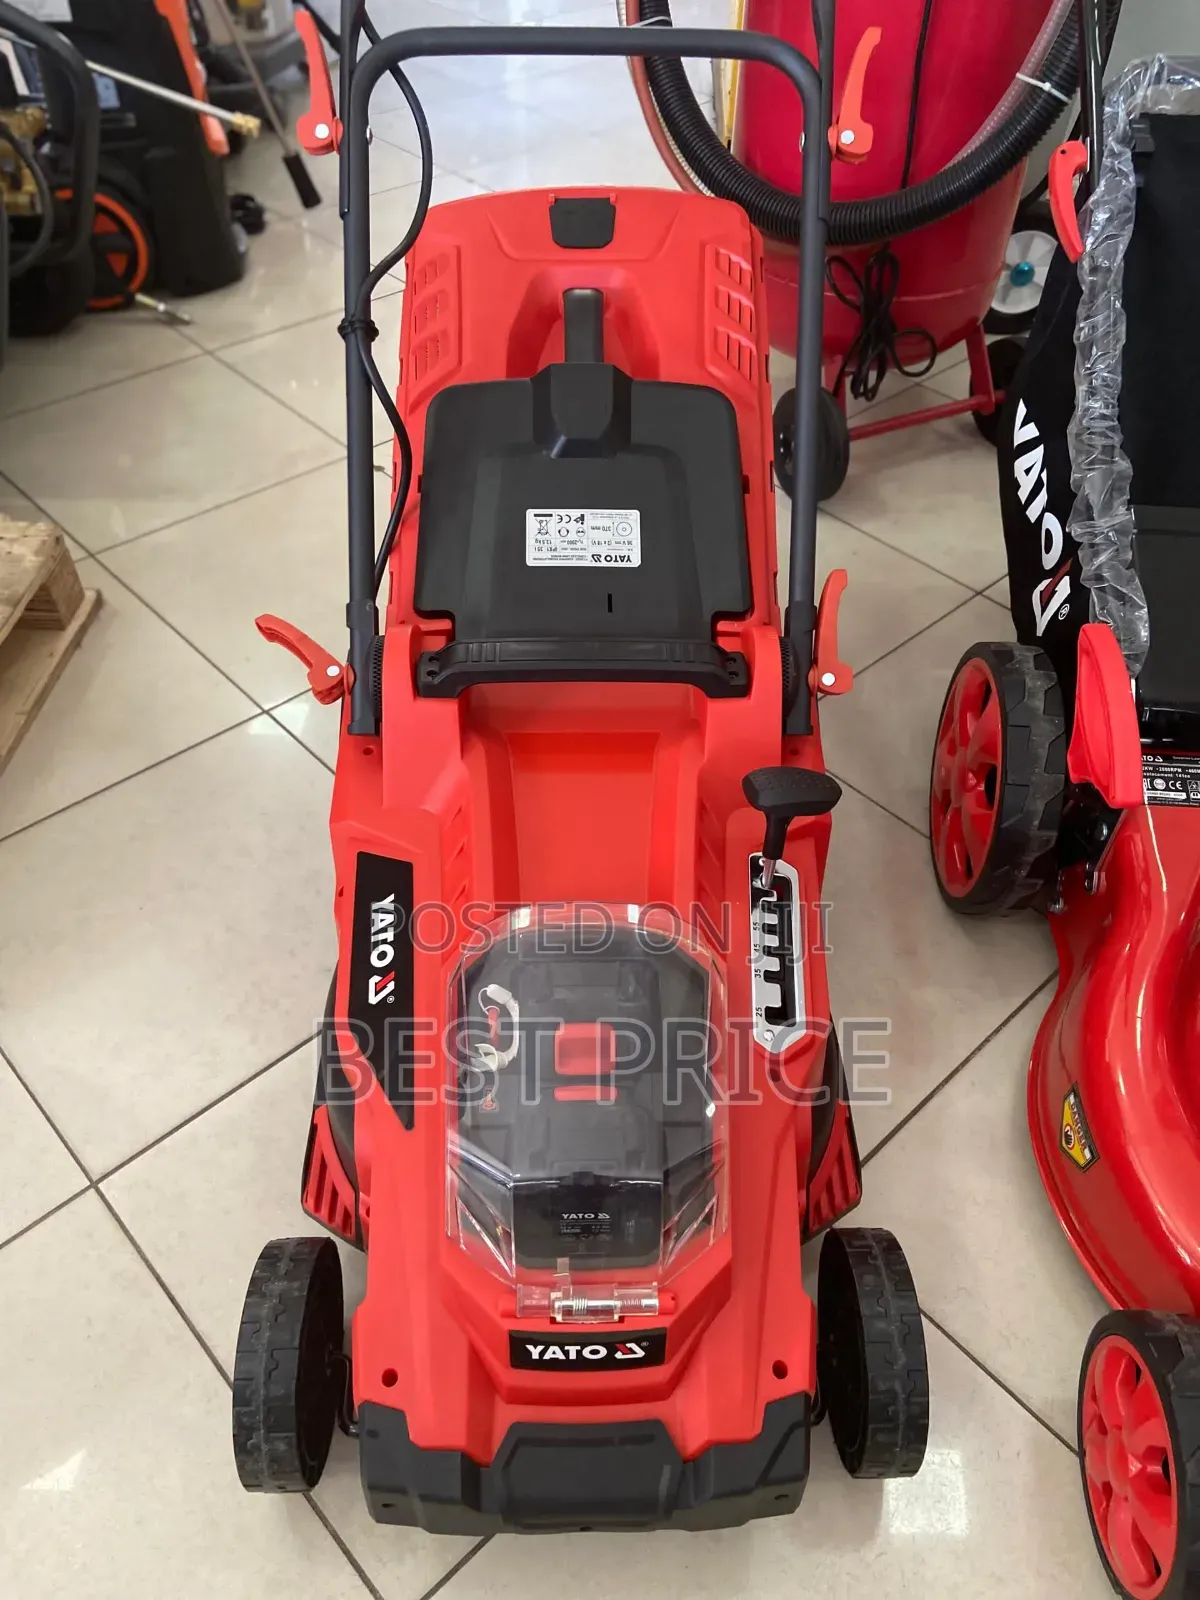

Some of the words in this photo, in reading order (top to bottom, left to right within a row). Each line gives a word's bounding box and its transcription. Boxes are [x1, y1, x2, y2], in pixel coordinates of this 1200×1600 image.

[1014, 398, 1063, 571] YATO
[604, 554, 633, 563] YATO
[369, 893, 395, 968] YATO
[752, 921, 760, 931] 55
[753, 943, 761, 953] 45
[754, 968, 762, 978] 35
[755, 1006, 763, 1018] 25
[525, 1344, 608, 1360] YATO
